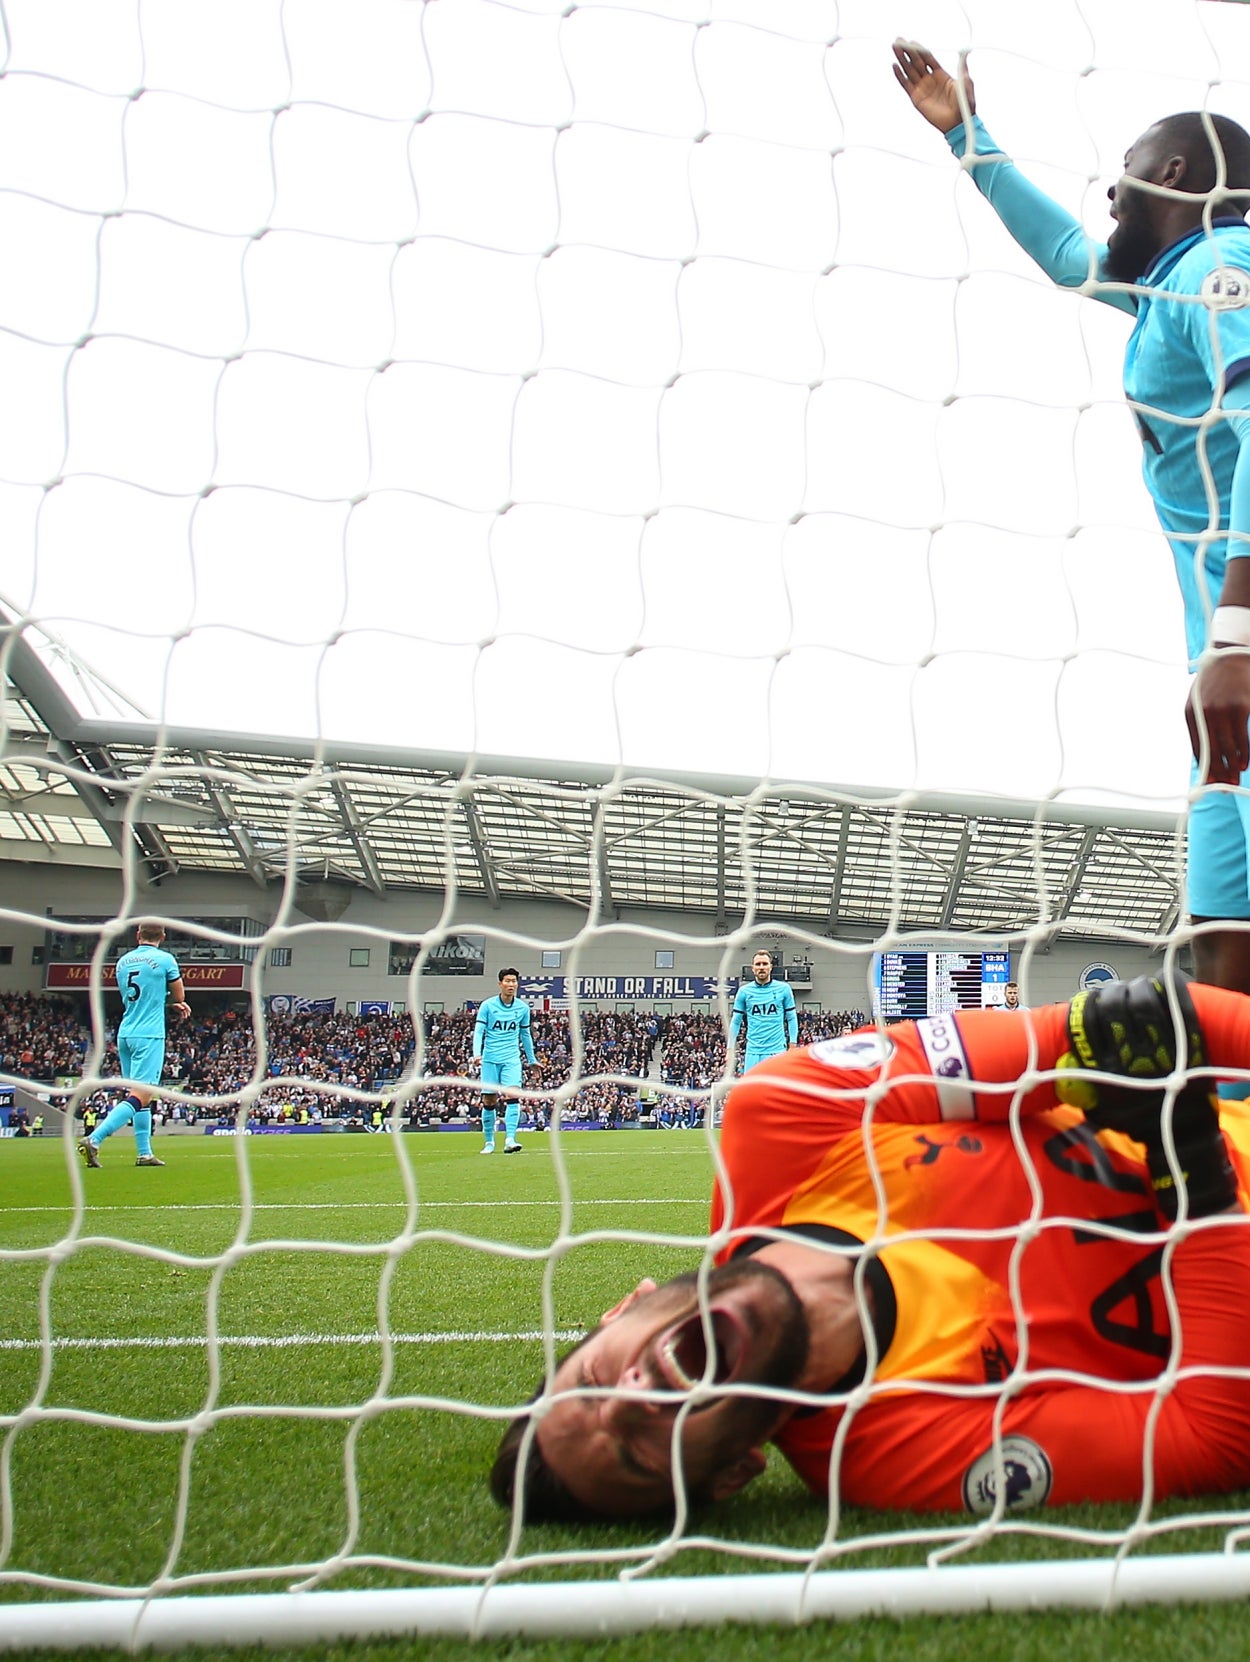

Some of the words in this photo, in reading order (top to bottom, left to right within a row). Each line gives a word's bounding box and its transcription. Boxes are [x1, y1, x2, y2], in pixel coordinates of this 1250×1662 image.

[985, 954, 1005, 962] 12:32
[985, 963, 1005, 972] BHA
[127, 970, 141, 1002] 5
[563, 978, 617, 994] STAND
[624, 977, 645, 994] OR
[653, 977, 694, 994] FALL
[752, 1004, 778, 1015] AIA
[492, 1020, 516, 1031] AIA
